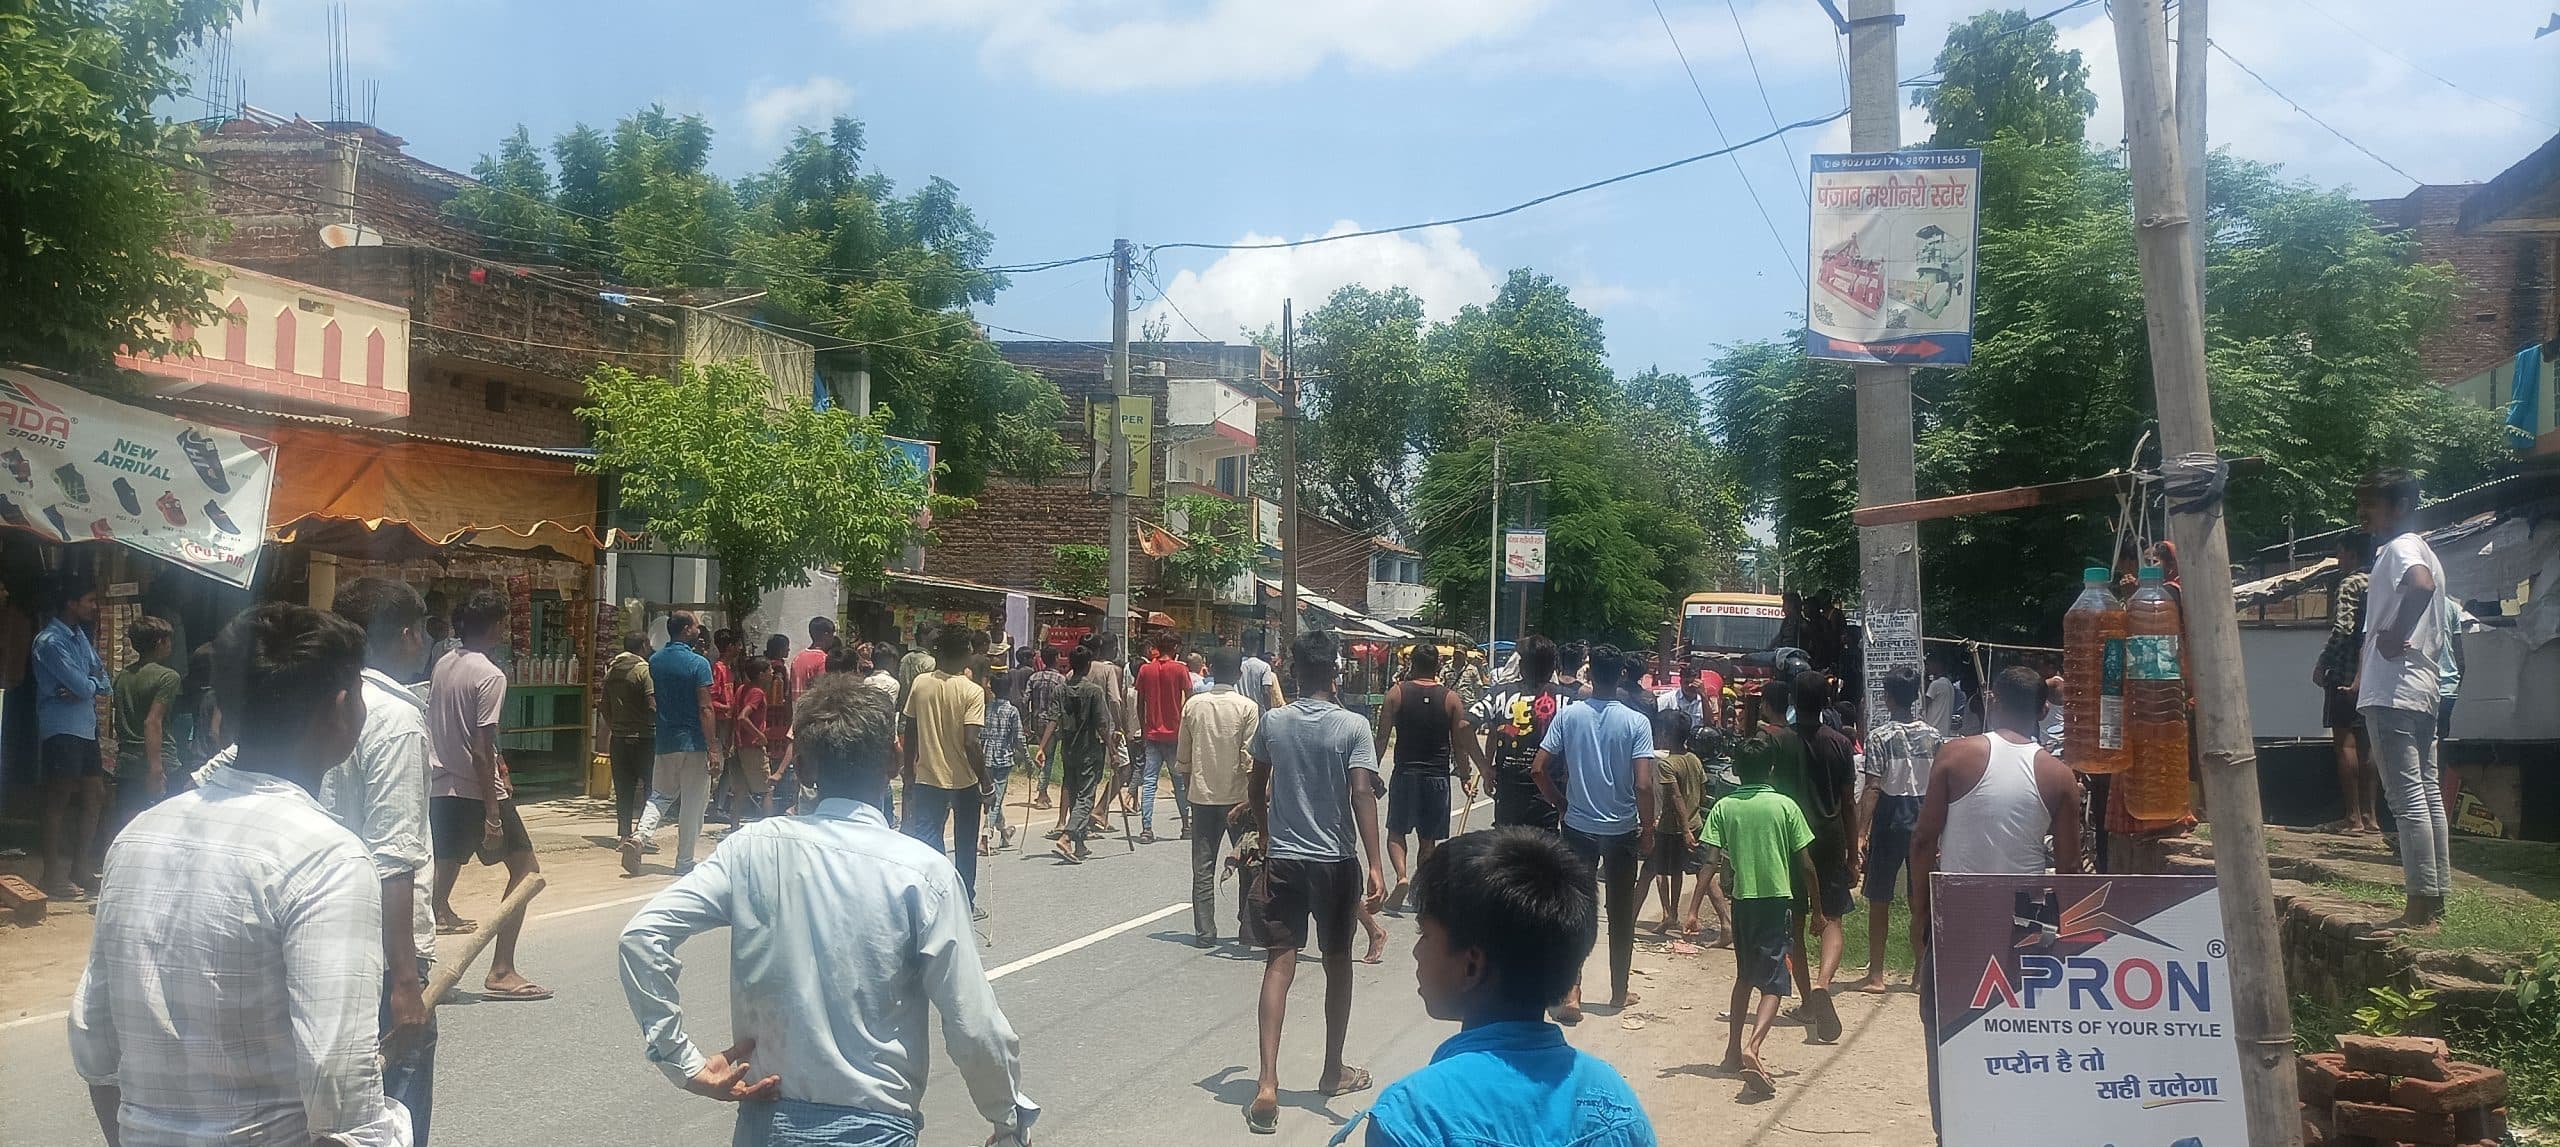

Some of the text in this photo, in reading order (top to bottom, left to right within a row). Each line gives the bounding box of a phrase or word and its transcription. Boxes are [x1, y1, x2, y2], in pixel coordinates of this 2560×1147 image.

[1816, 175, 1967, 208] पंजाब मशीनरी स्टोर
[1121, 415, 1144, 425] PER
[6, 428, 67, 450] SPORTS
[113, 438, 158, 461] NEW
[93, 450, 171, 482] ARRIVAL
[1699, 606, 1712, 614] PG
[1717, 606, 1750, 615] PUBLIC
[1969, 953, 2211, 1012] APRON
[1984, 1018, 2222, 1038] MOMENTS OF YOUR STYLE
[2055, 1048, 2073, 1073] है
[2077, 1047, 2105, 1072] तो
[2095, 1072, 2218, 1099] सही चलेगा
